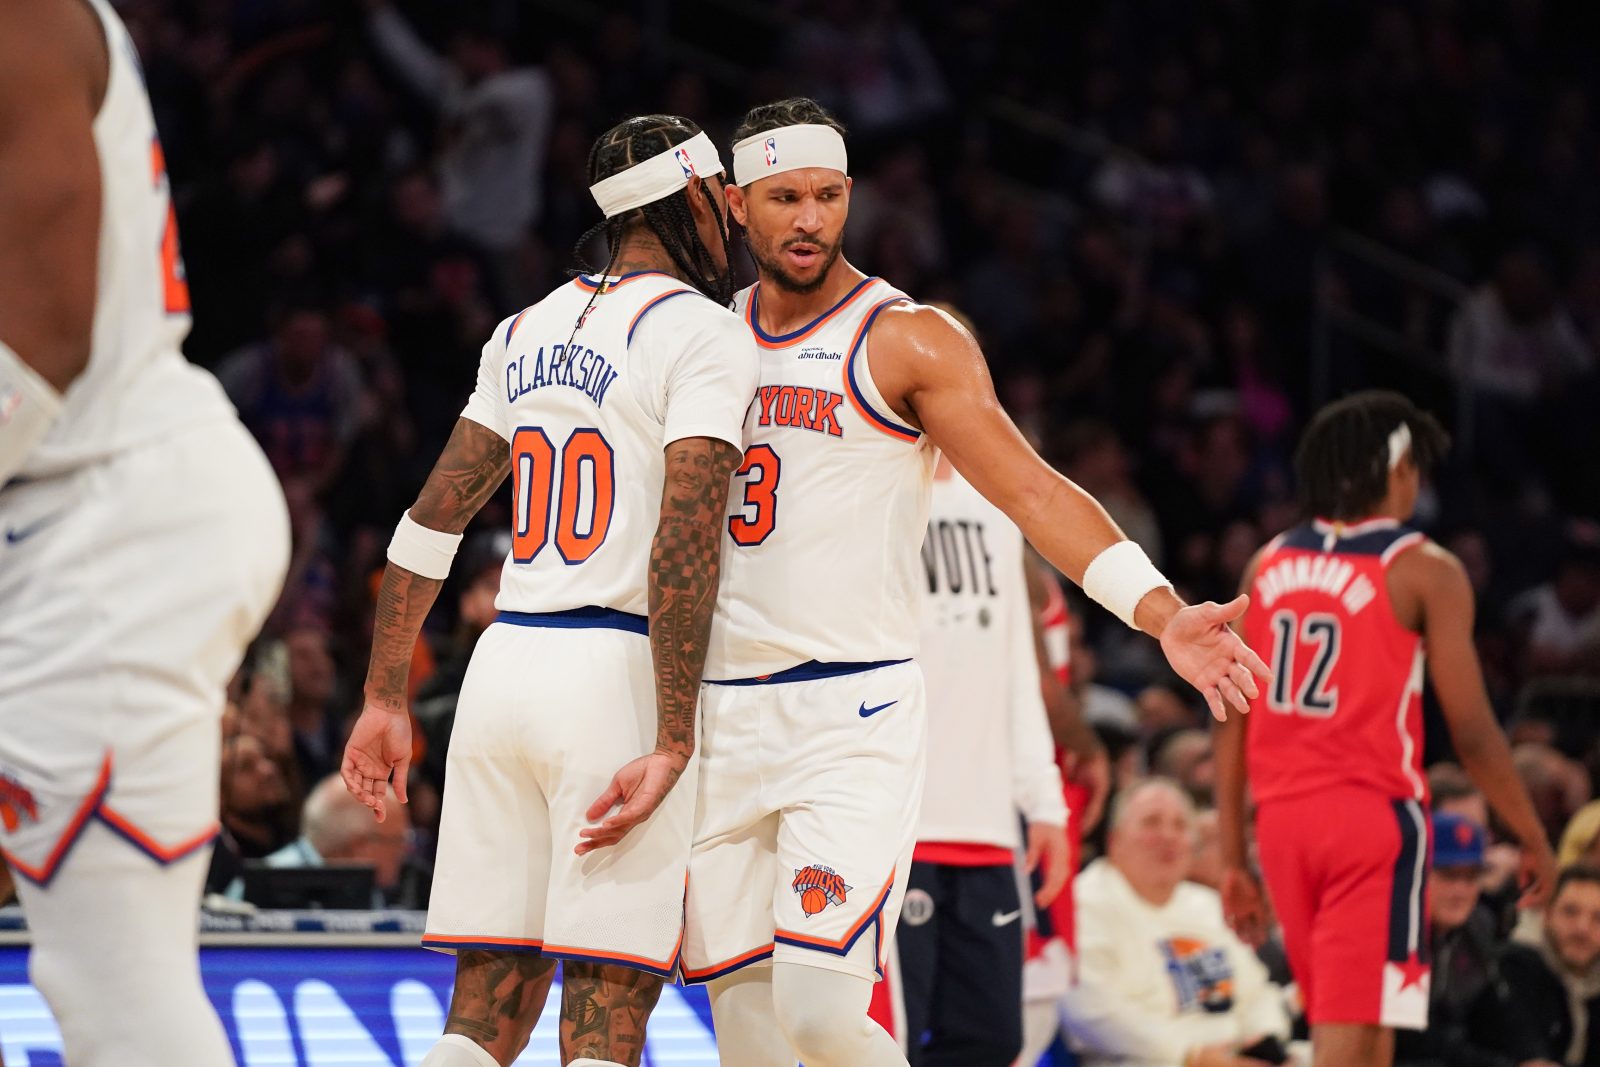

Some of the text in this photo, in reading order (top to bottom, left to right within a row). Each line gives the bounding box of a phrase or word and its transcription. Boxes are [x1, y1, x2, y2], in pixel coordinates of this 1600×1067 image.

[506, 344, 618, 408] CLARKSON
[798, 352, 842, 360] abu dhabi
[759, 385, 844, 438] YORK
[511, 426, 615, 565] 00
[728, 443, 781, 546] 3
[1256, 555, 1354, 608] JOHNSON
[1266, 608, 1342, 718] 12
[792, 866, 847, 903] KNICKS
